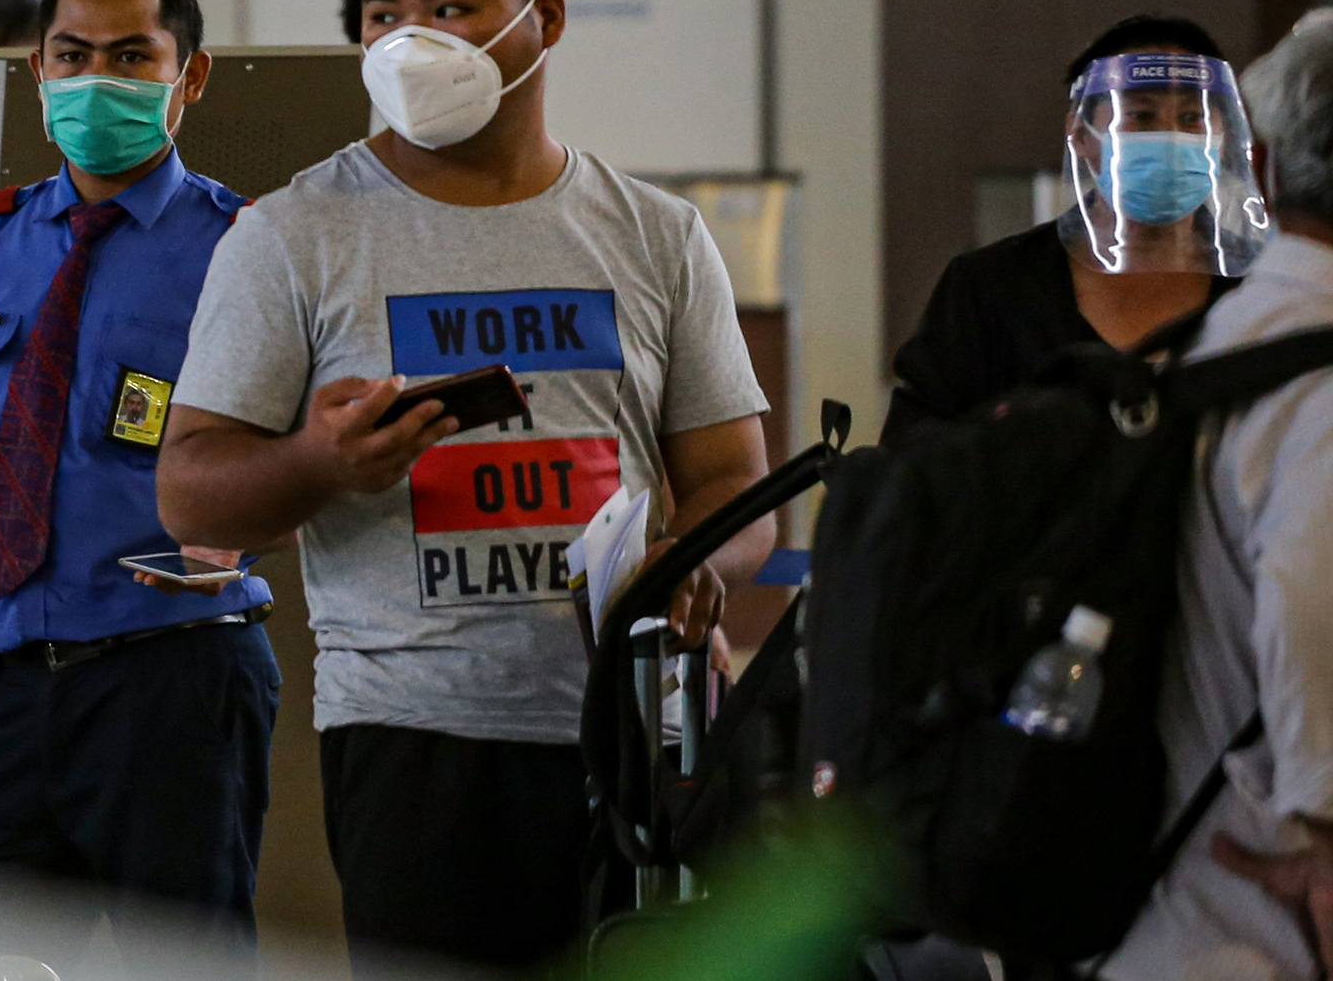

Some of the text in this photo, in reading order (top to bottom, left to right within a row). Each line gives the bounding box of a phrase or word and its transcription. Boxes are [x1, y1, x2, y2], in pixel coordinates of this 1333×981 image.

[1133, 67, 1209, 80] FACE SHIELD
[427, 303, 585, 356] WORK
[473, 460, 573, 513] OUT
